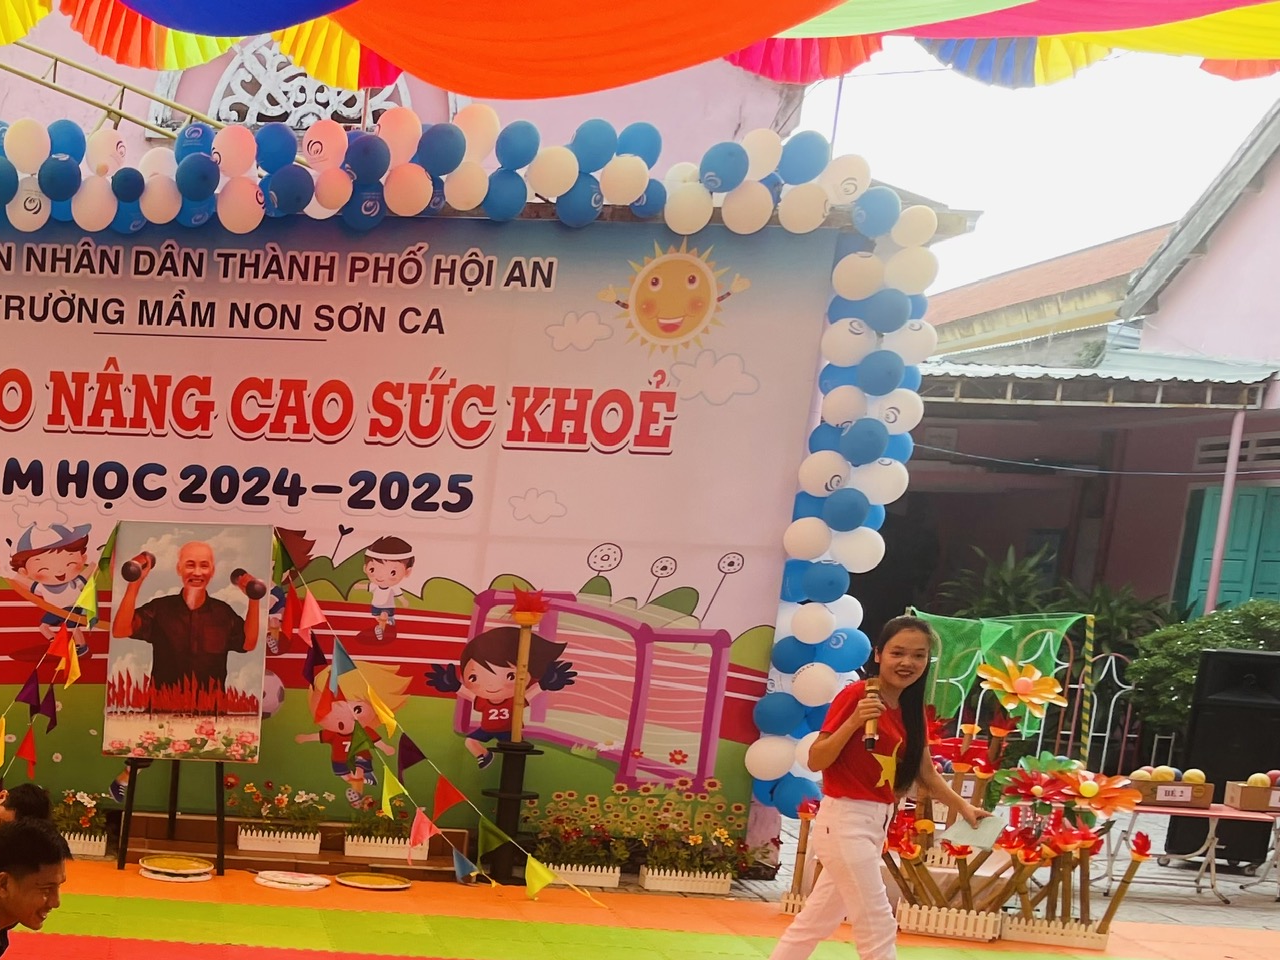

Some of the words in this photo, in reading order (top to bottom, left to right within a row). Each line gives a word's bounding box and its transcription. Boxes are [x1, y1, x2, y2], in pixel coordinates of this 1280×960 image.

[25, 242, 120, 275] NHÂN
[133, 244, 204, 278] DÂN
[216, 246, 336, 283] THÀNH
[348, 246, 425, 285] PHỐ
[433, 250, 494, 292] HỘI
[503, 260, 554, 288] AN
[138, 289, 216, 328] MẦM
[228, 303, 302, 331] NON
[313, 302, 386, 333] SƠN
[398, 307, 445, 335] CA
[45, 357, 217, 435] NÂNG
[228, 377, 356, 441] CAO
[365, 367, 497, 446] SỨC
[504, 369, 677, 452] KHOẺ
[56, 460, 168, 510] HỌC
[488, 708, 510, 720] 23
[342, 741, 351, 753] 7
